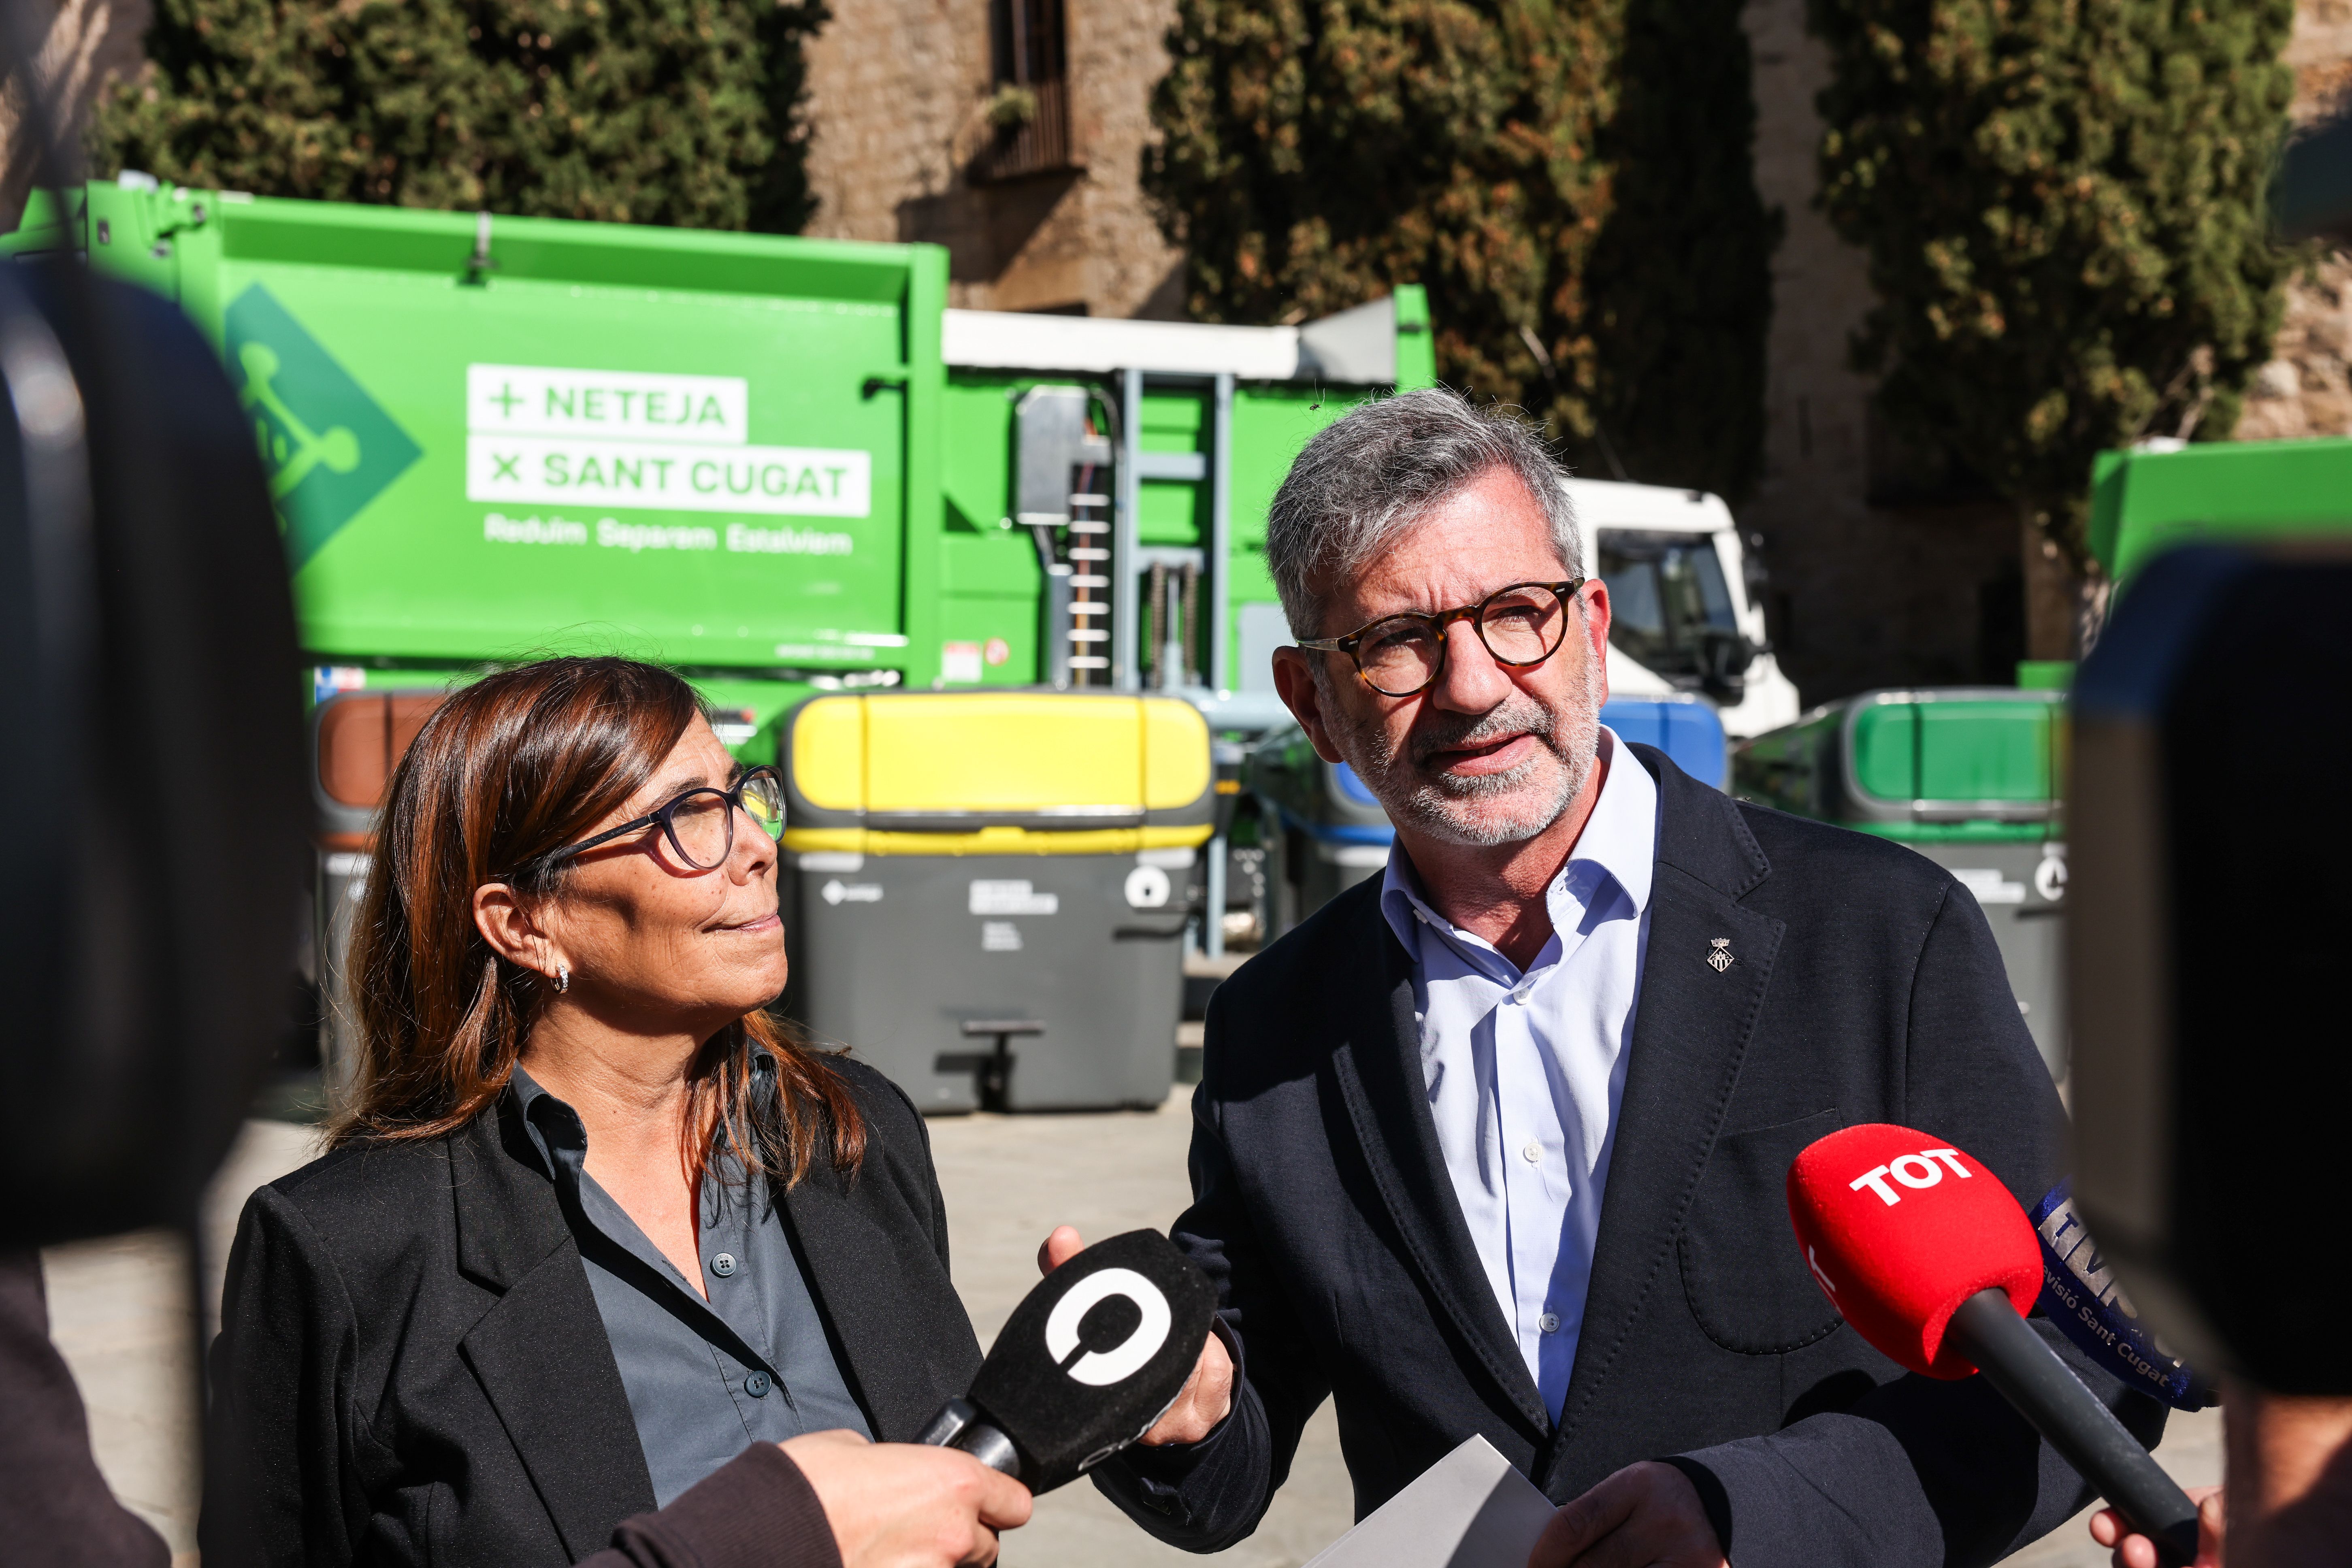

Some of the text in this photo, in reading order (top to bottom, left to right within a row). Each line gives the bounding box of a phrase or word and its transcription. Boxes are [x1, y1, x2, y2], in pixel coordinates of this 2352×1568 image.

[544, 386, 726, 426] NETEJA
[543, 452, 675, 491] SANT
[690, 459, 848, 499] CUGAT
[597, 517, 717, 553] Separem
[726, 523, 853, 556] Estalviem
[1849, 1148, 1972, 1206] TOT
[2043, 1257, 2079, 1309] evisió
[2078, 1306, 2116, 1346] Sant
[2118, 1342, 2170, 1387] Cugat
